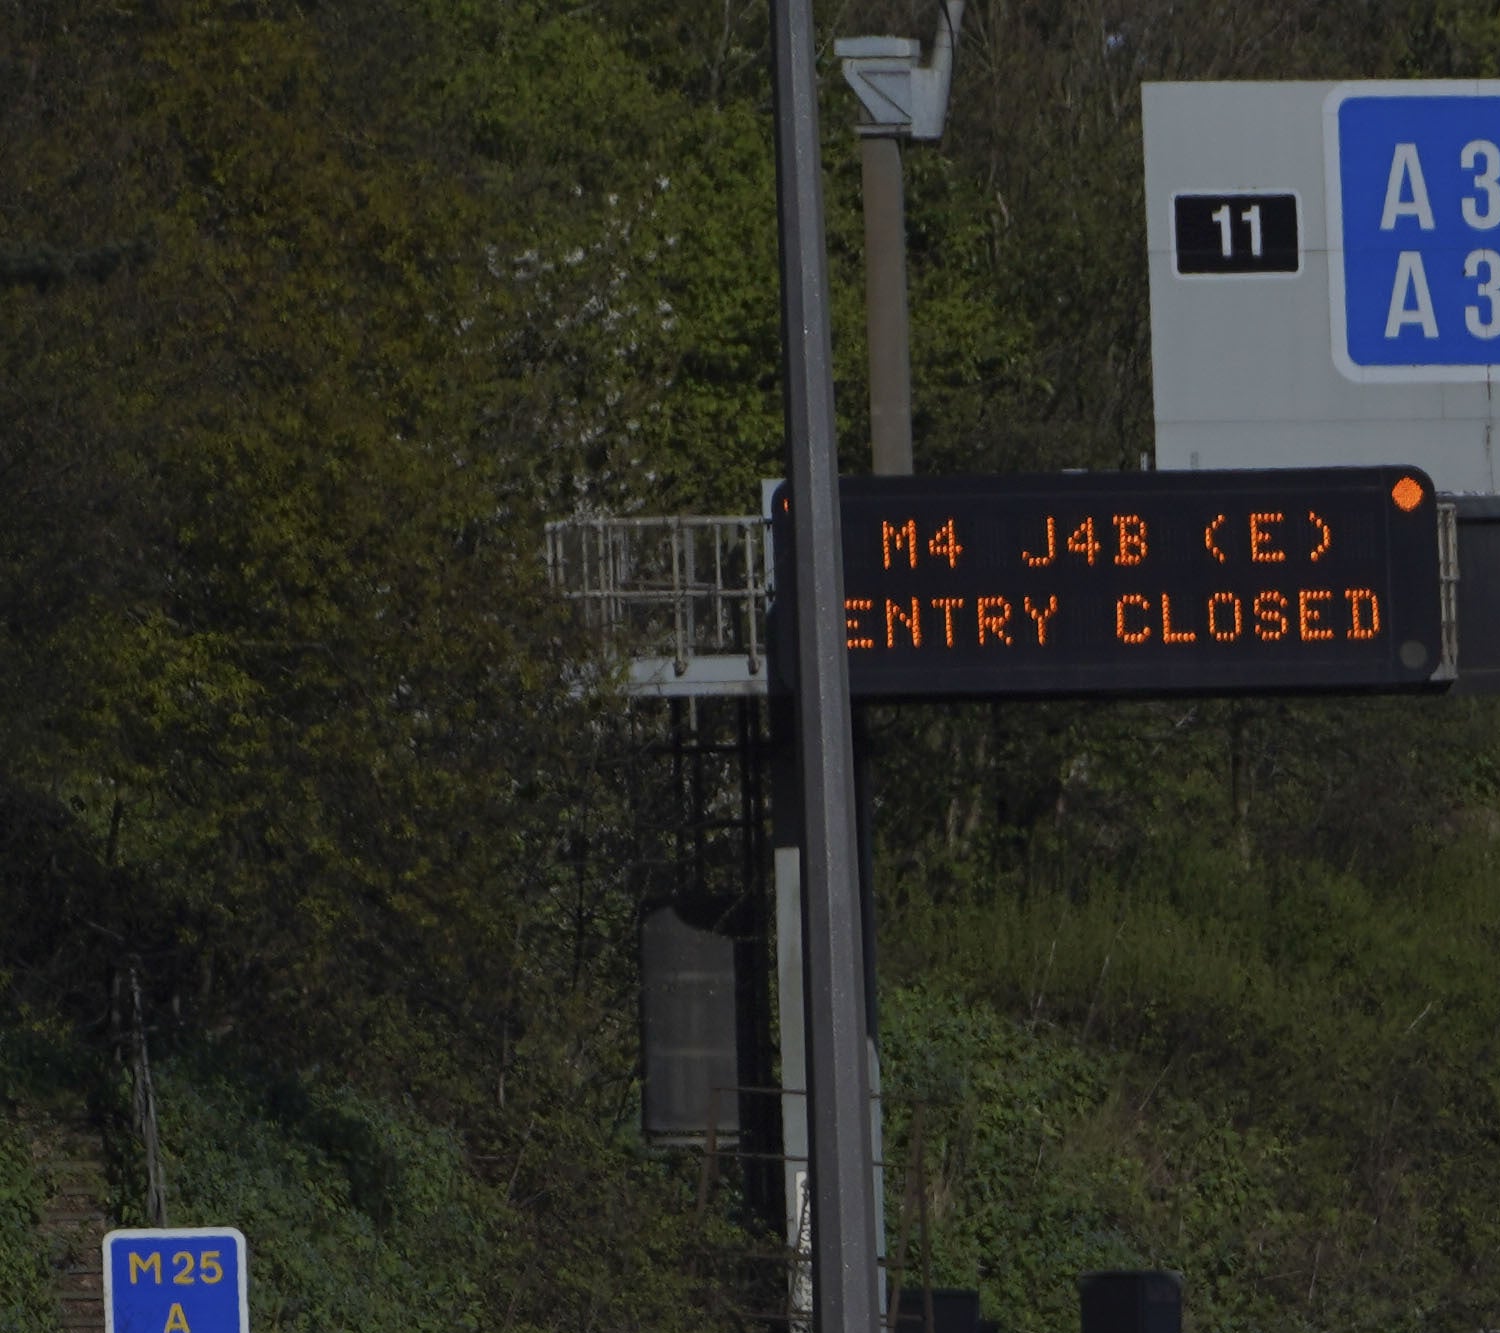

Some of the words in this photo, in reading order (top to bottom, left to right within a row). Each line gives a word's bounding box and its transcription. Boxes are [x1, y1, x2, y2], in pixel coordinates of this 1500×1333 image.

[1211, 203, 1264, 258] 11
[884, 518, 964, 568] M4
[1022, 514, 1149, 567] J4B
[1205, 513, 1332, 563] (E)
[846, 596, 1057, 647] ENTRY
[1116, 587, 1381, 645] CLOSED
[129, 1251, 225, 1285] M25
